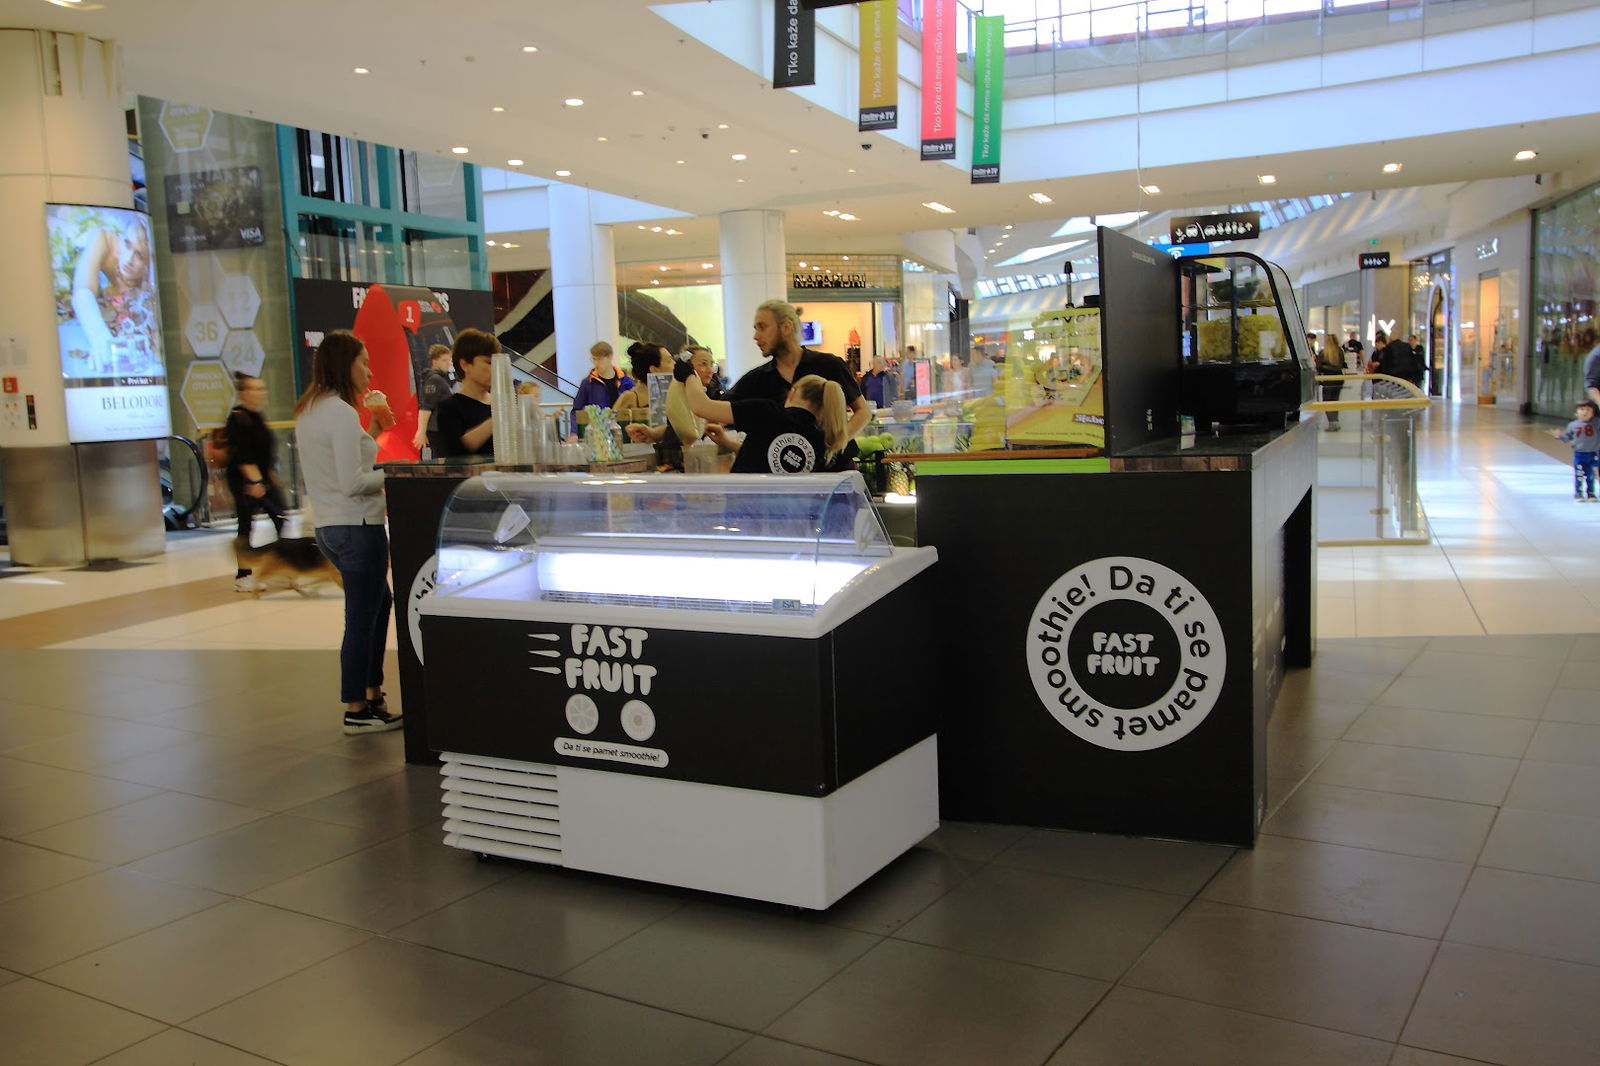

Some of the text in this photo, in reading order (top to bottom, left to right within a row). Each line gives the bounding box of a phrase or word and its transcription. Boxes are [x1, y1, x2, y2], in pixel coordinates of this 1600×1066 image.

[787, 18, 798, 49] kaže
[787, 52, 798, 76] Tko
[872, 80, 881, 100] Tko
[934, 95, 942, 116] kaže
[934, 117, 942, 132] Tko
[982, 125, 990, 142] kaže
[982, 144, 990, 159] Tko
[240, 226, 262, 240] VISA
[406, 306, 414, 323] 1
[194, 320, 218, 342] 36
[232, 346, 256, 366] 24
[1576, 424, 1594, 437] 78
[798, 437, 808, 450] Da
[570, 624, 649, 660] FAST
[1092, 631, 1155, 654] FAST
[1038, 565, 1211, 740] Da ti se pamet smoothie!
[1087, 654, 1160, 676] FRUIT
[564, 658, 657, 696] FRUIT
[563, 742, 574, 750] Da
[593, 747, 618, 756] pamet
[620, 750, 660, 762] smoothie!
